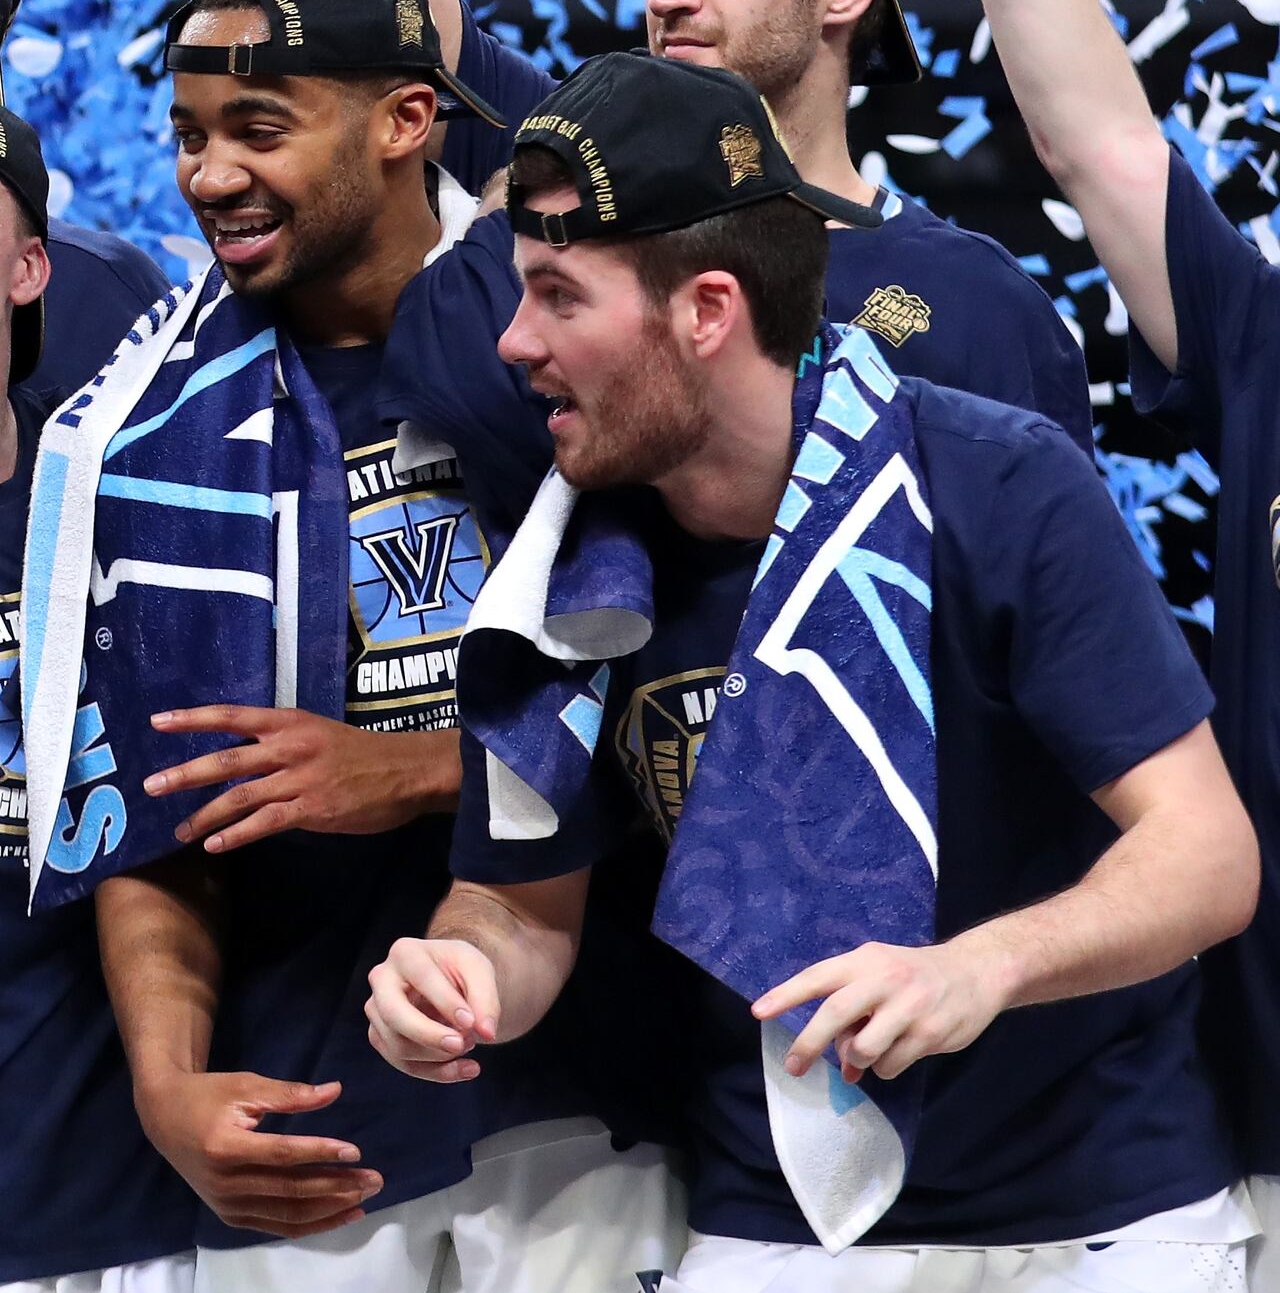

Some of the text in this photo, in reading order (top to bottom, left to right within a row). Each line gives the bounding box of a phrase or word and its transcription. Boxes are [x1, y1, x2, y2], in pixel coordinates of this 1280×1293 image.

[578, 138, 617, 222] CHAMPIONS
[868, 305, 913, 331] FOUR
[870, 292, 922, 320] FINAL
[362, 516, 459, 617] V
[357, 646, 459, 694] CHAMPI
